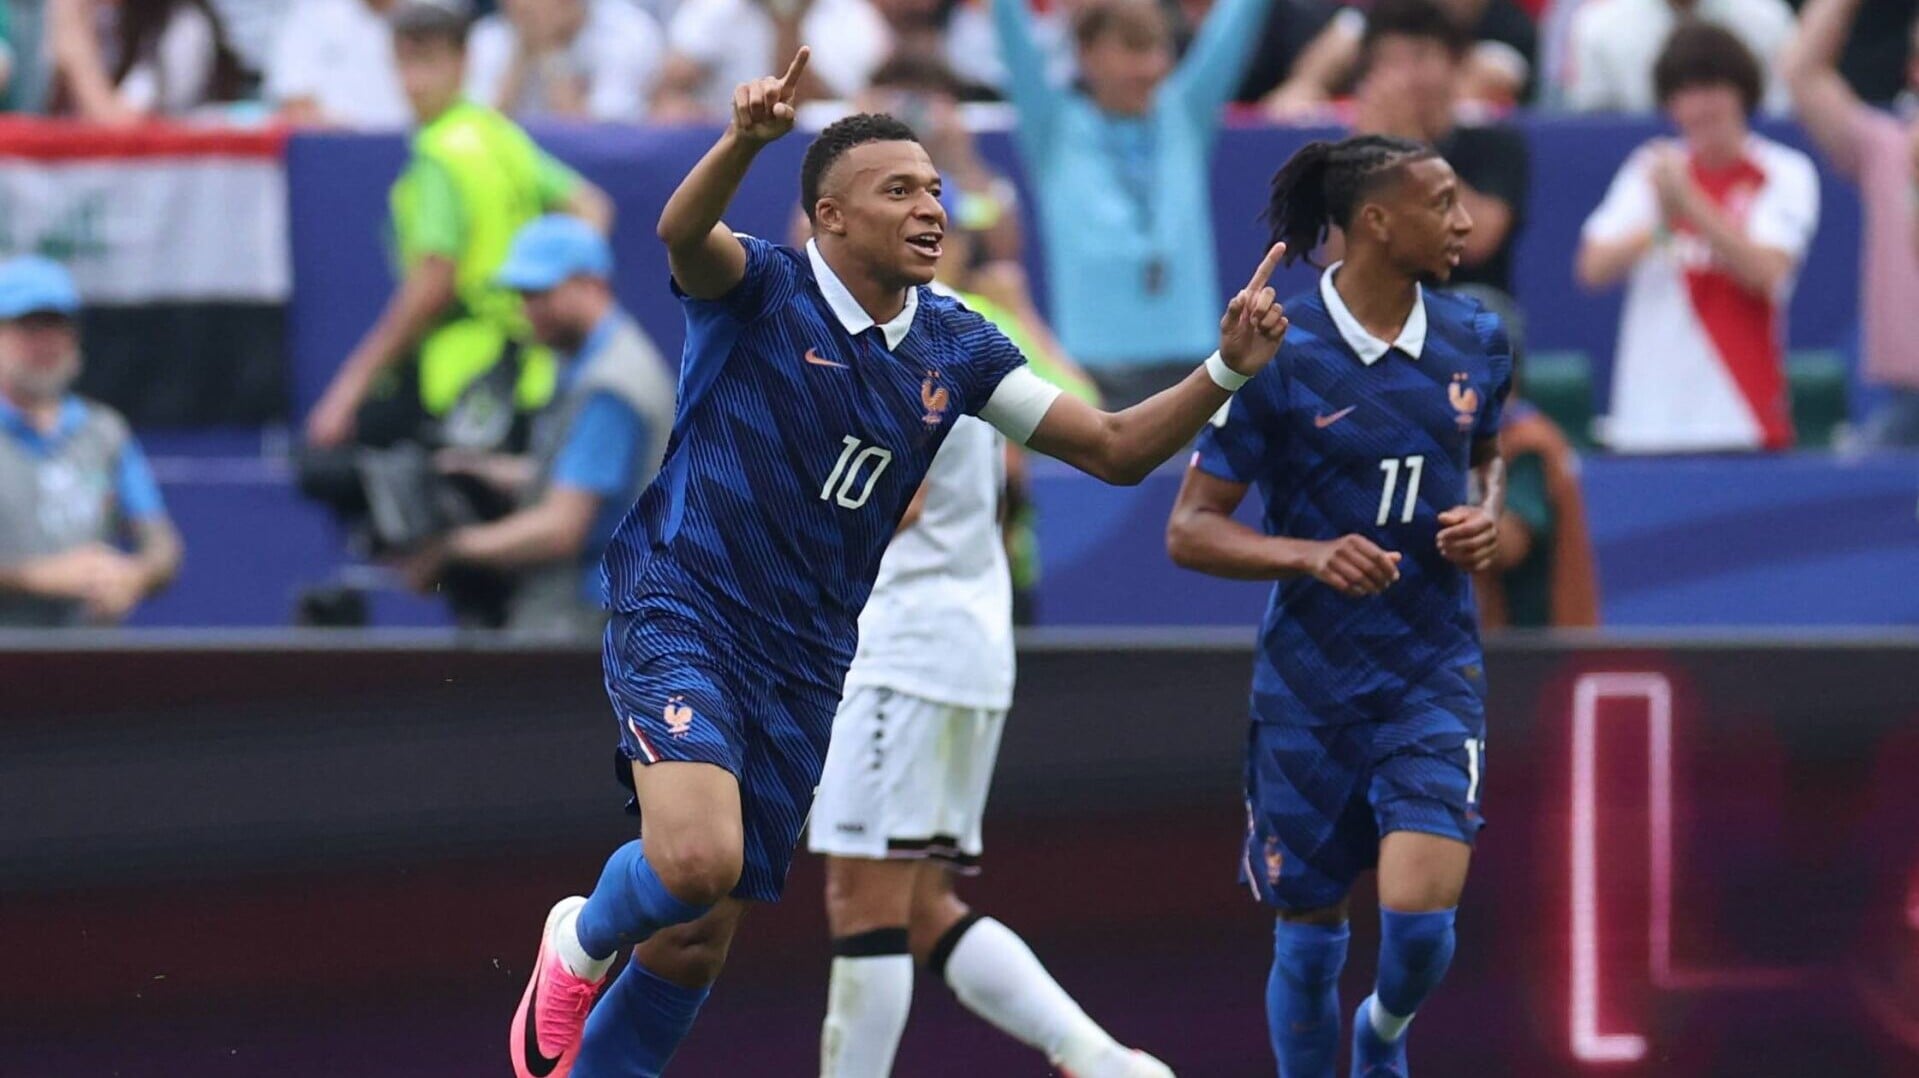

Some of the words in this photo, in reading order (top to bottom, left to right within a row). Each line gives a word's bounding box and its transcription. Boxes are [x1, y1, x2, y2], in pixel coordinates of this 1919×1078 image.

[820, 434, 892, 509] 10
[1376, 454, 1424, 526] 11
[1464, 738, 1485, 803] 1
